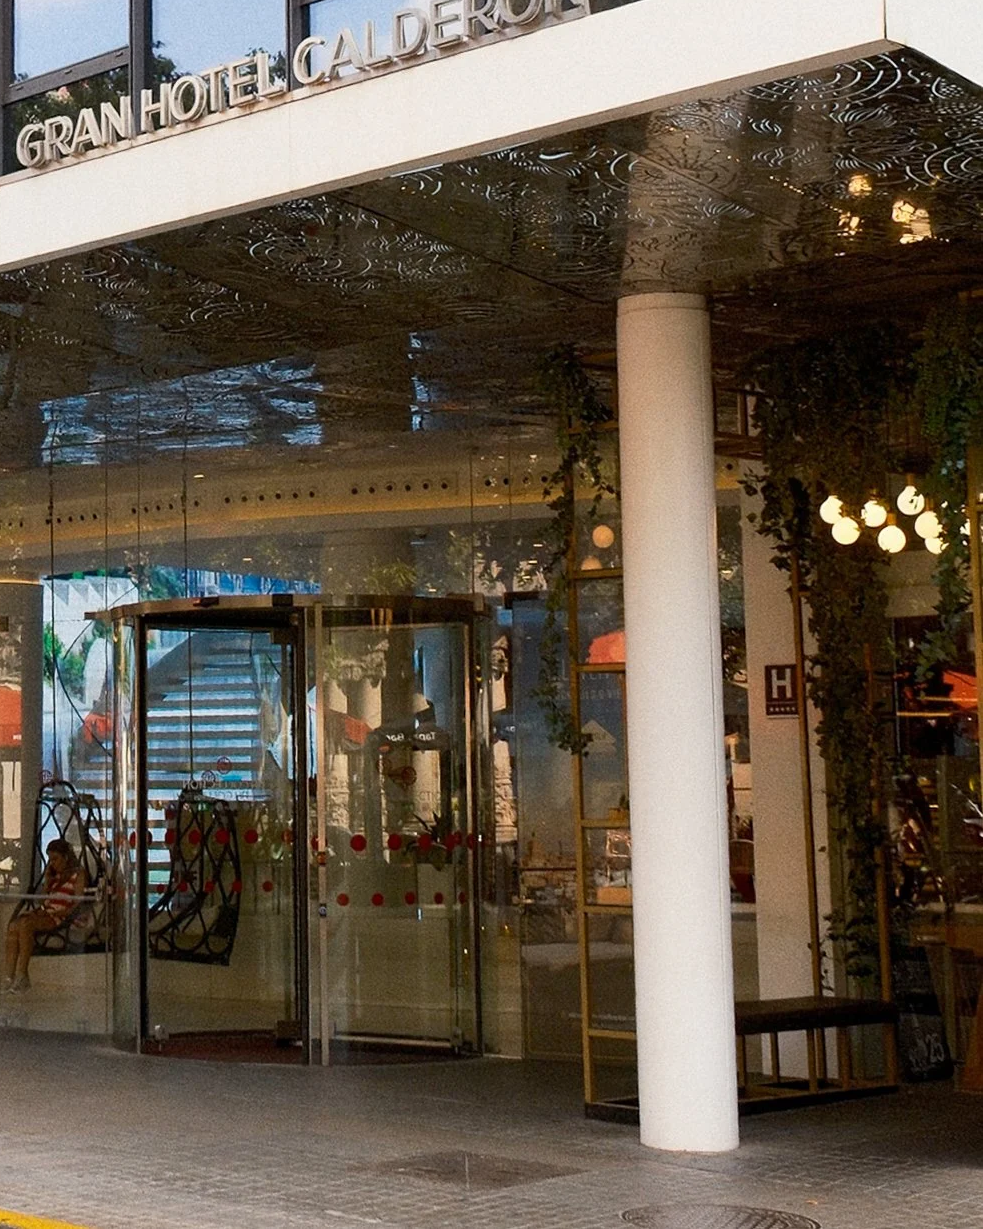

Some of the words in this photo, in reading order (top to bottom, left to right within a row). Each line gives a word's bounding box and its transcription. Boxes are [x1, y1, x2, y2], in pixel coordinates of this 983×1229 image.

[16, 96, 135, 169] GRAN
[140, 52, 286, 132] HOTEL
[770, 667, 793, 699] H
